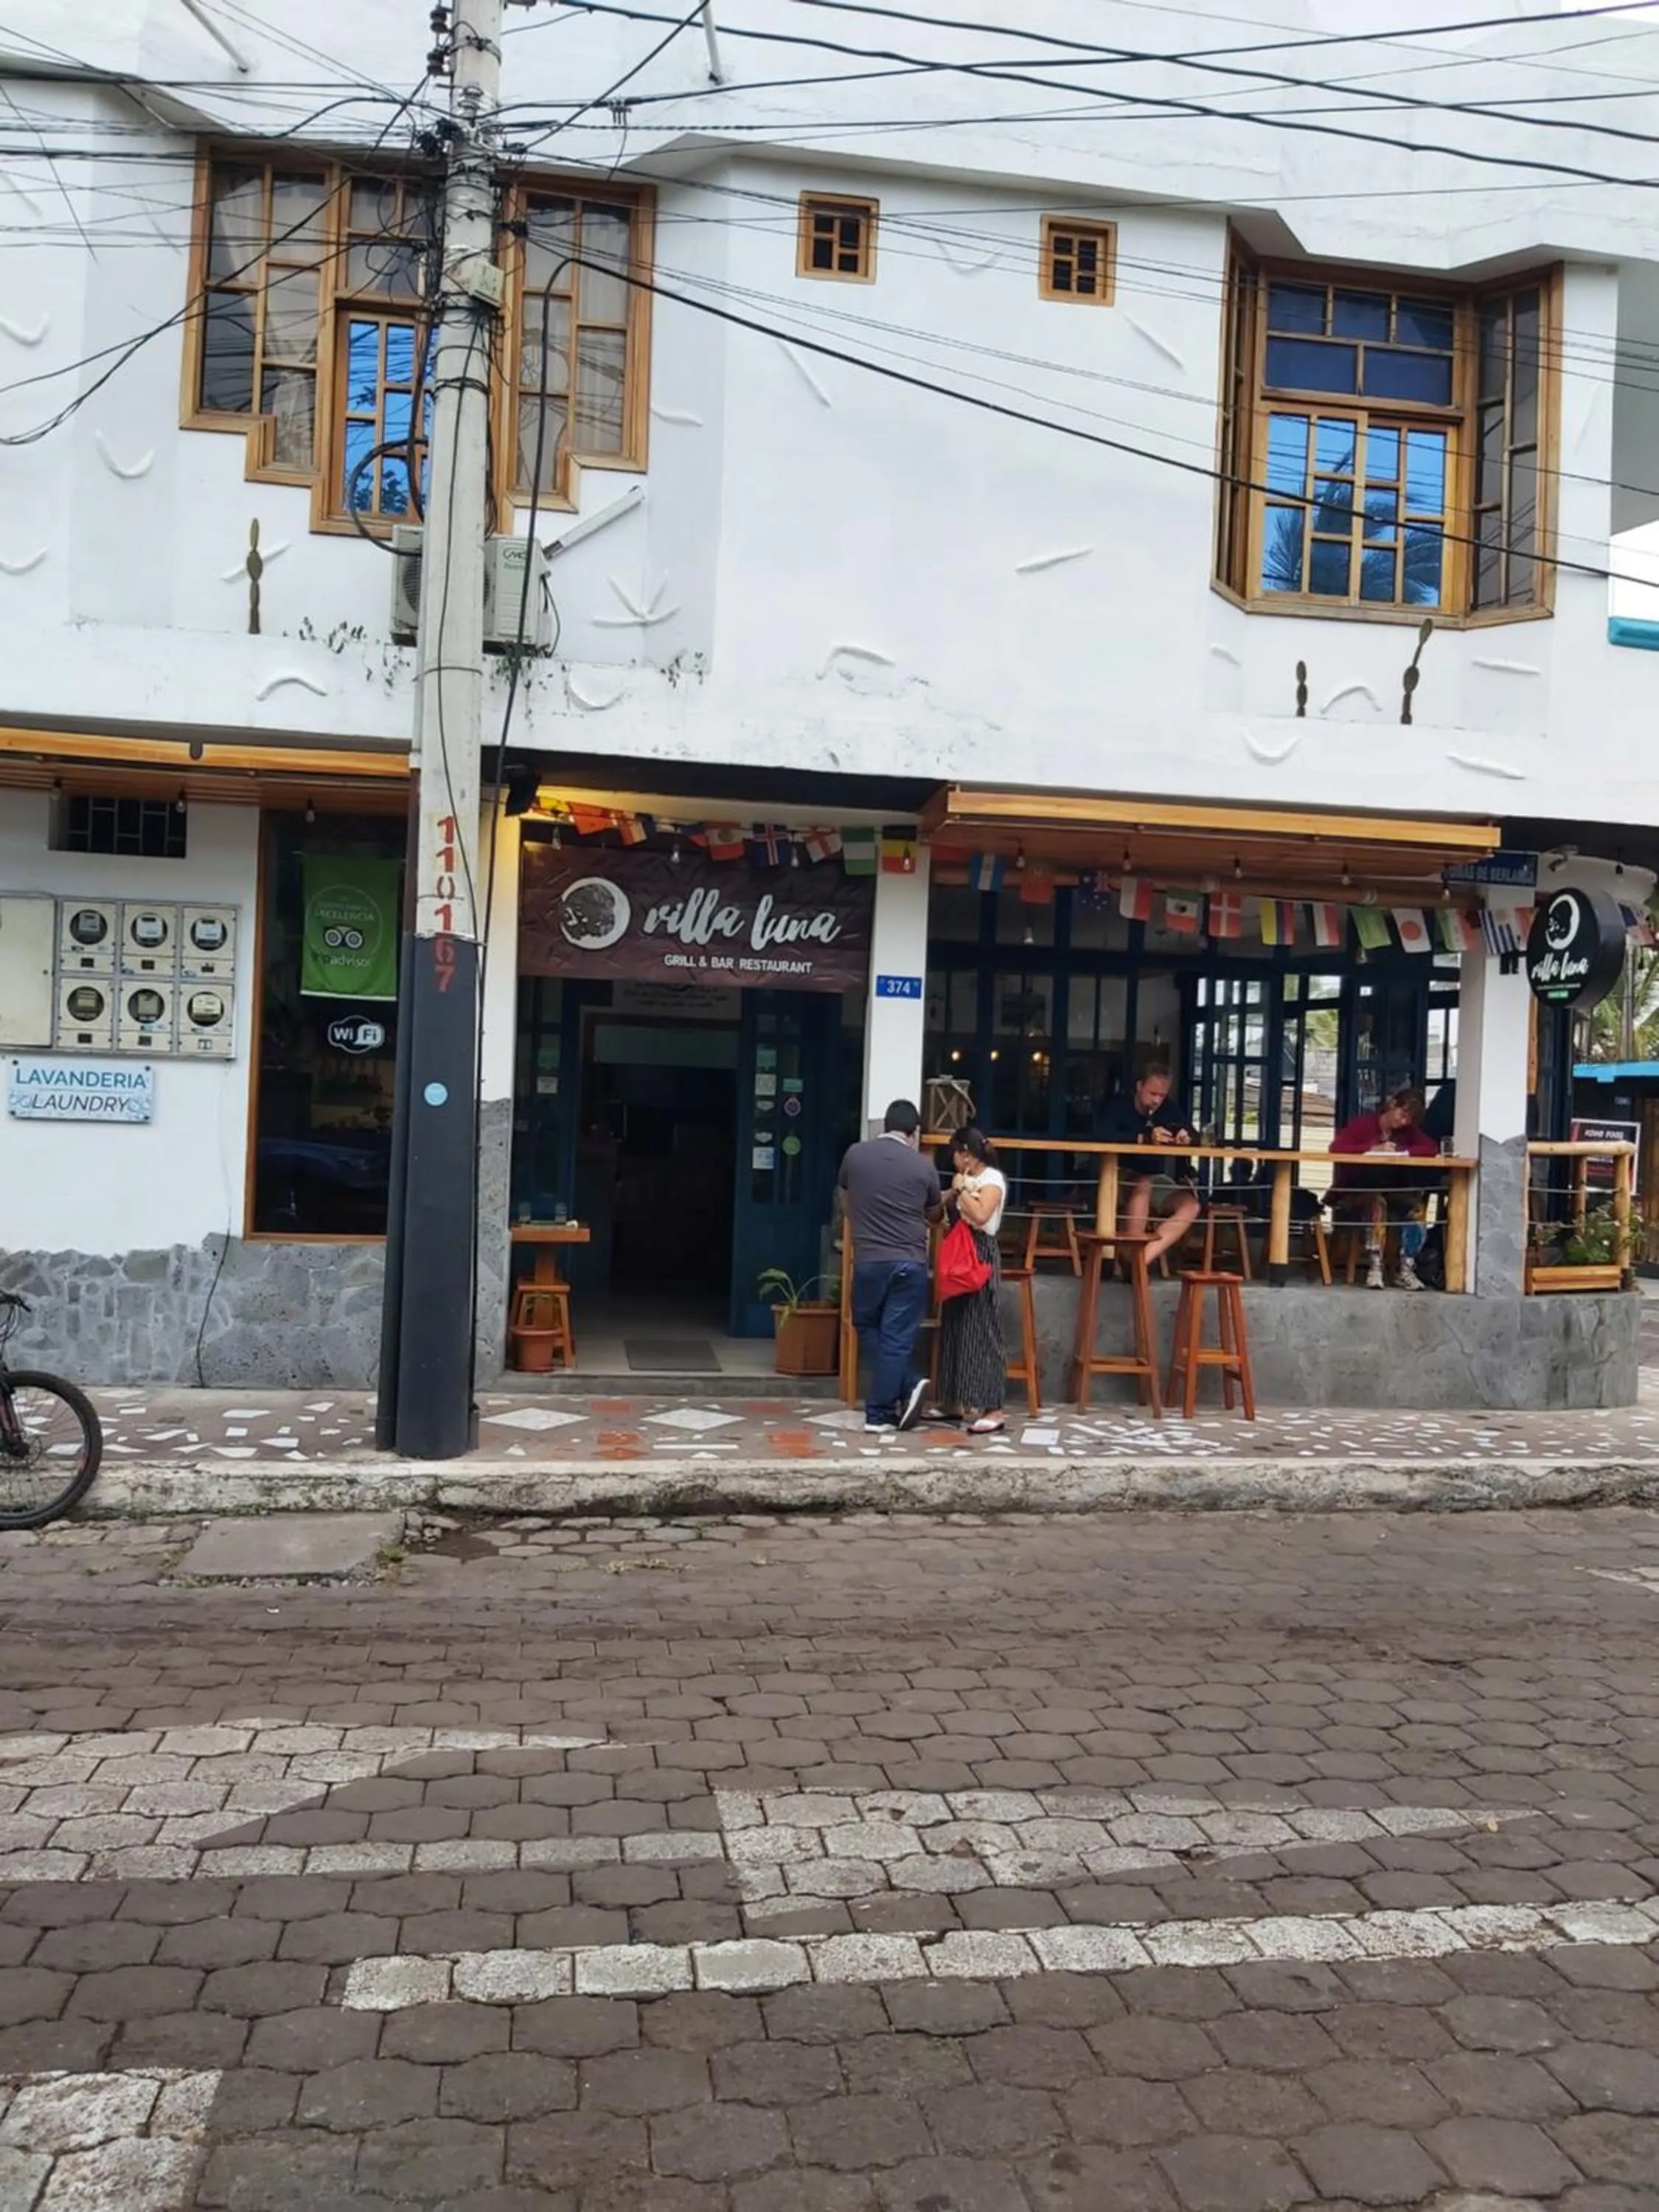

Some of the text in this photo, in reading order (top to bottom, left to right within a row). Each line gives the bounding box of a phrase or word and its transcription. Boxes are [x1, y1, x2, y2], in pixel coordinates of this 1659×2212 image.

[643, 887, 841, 952] villa luna
[664, 954, 813, 973] GRILL & BAR RESTAURANT
[886, 979, 911, 995] 374
[16, 1068, 146, 1089] LAVANDERIA
[32, 1094, 129, 1112] LAUNDRY
